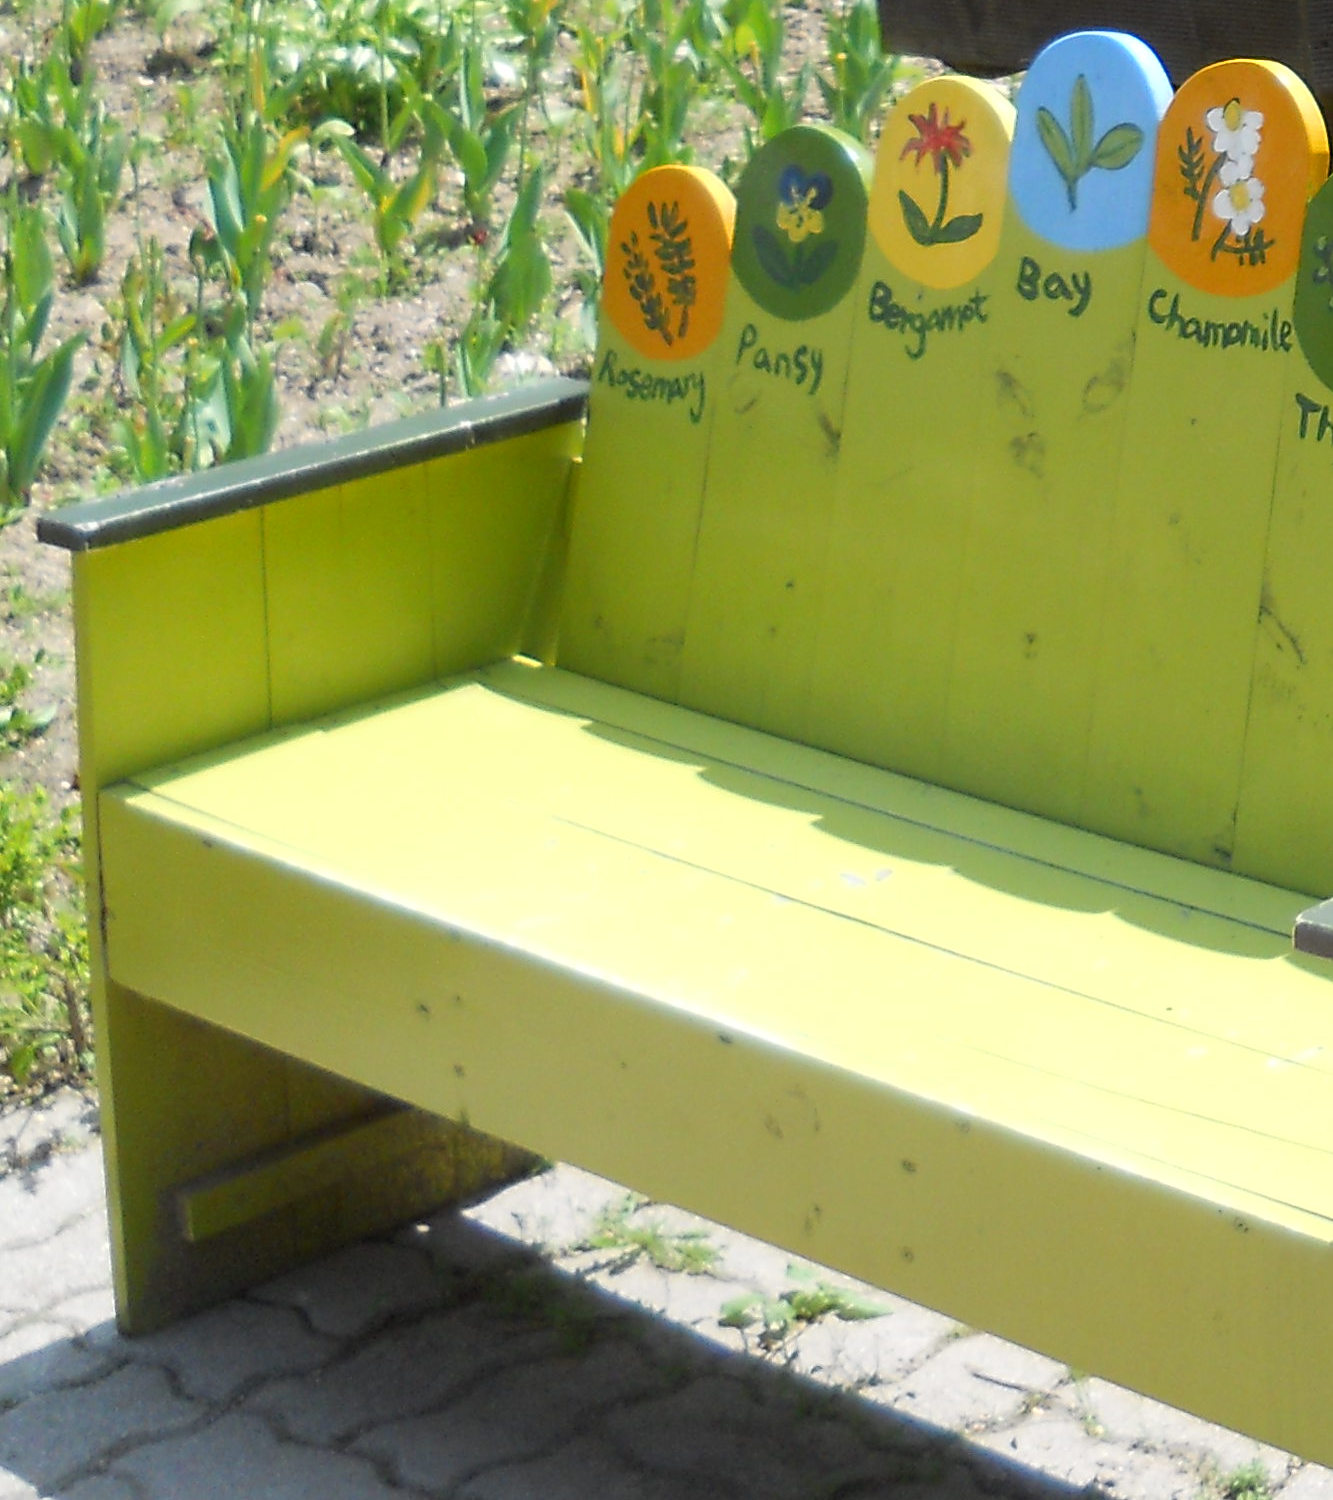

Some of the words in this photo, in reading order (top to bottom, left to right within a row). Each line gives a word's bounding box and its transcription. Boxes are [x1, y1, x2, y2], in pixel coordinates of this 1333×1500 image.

[868, 280, 989, 360] Bergamot
[1016, 256, 1092, 317] Bay
[1147, 288, 1294, 354] Chamomile
[598, 350, 706, 424] Rosemary
[735, 323, 824, 395] Pansy
